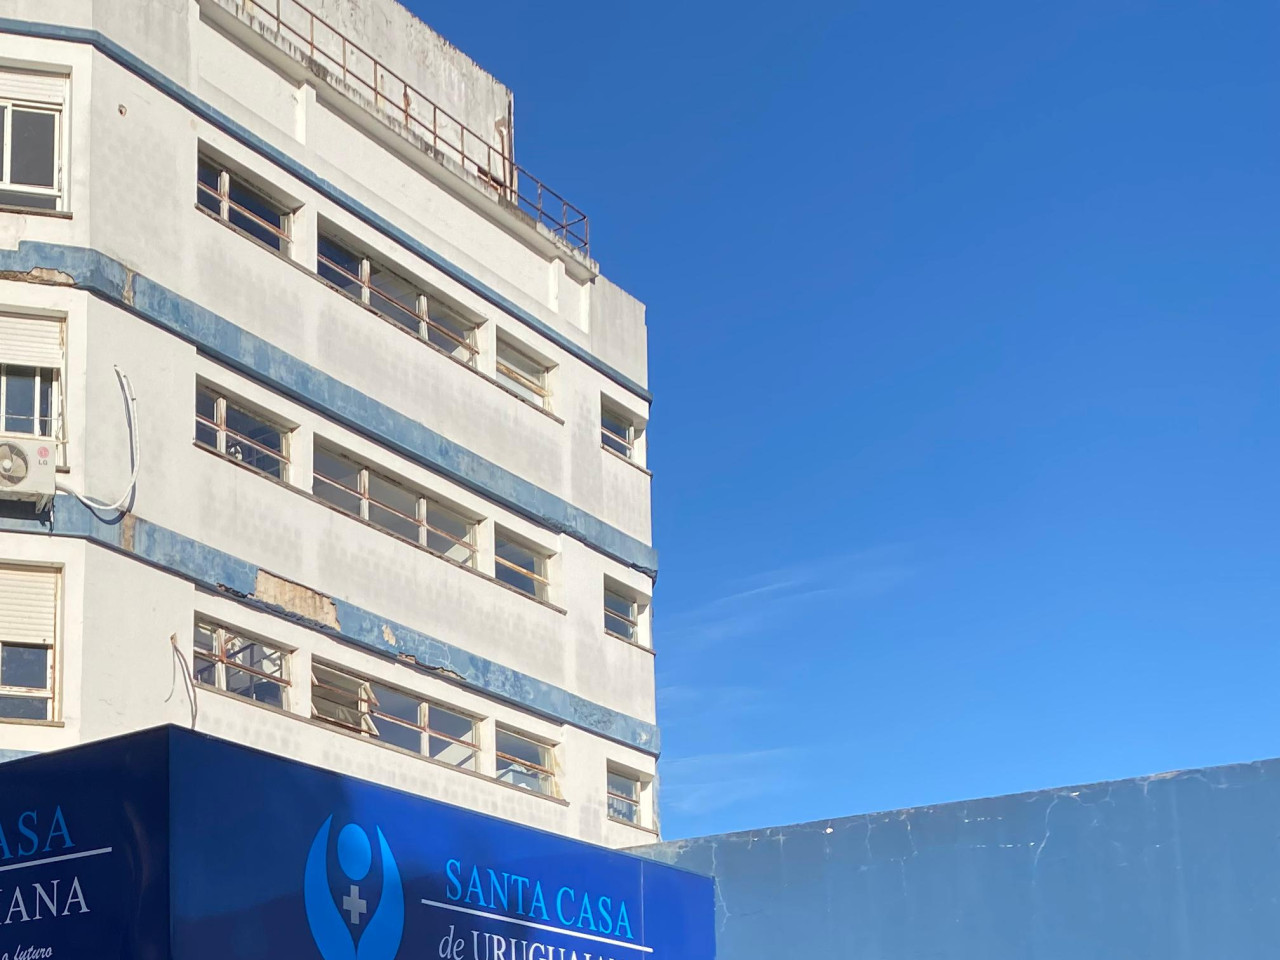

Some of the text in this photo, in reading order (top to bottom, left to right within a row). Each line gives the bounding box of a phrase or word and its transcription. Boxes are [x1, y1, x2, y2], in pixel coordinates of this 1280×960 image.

[445, 859, 634, 939] SANTA CASA
[439, 925, 465, 960] de
